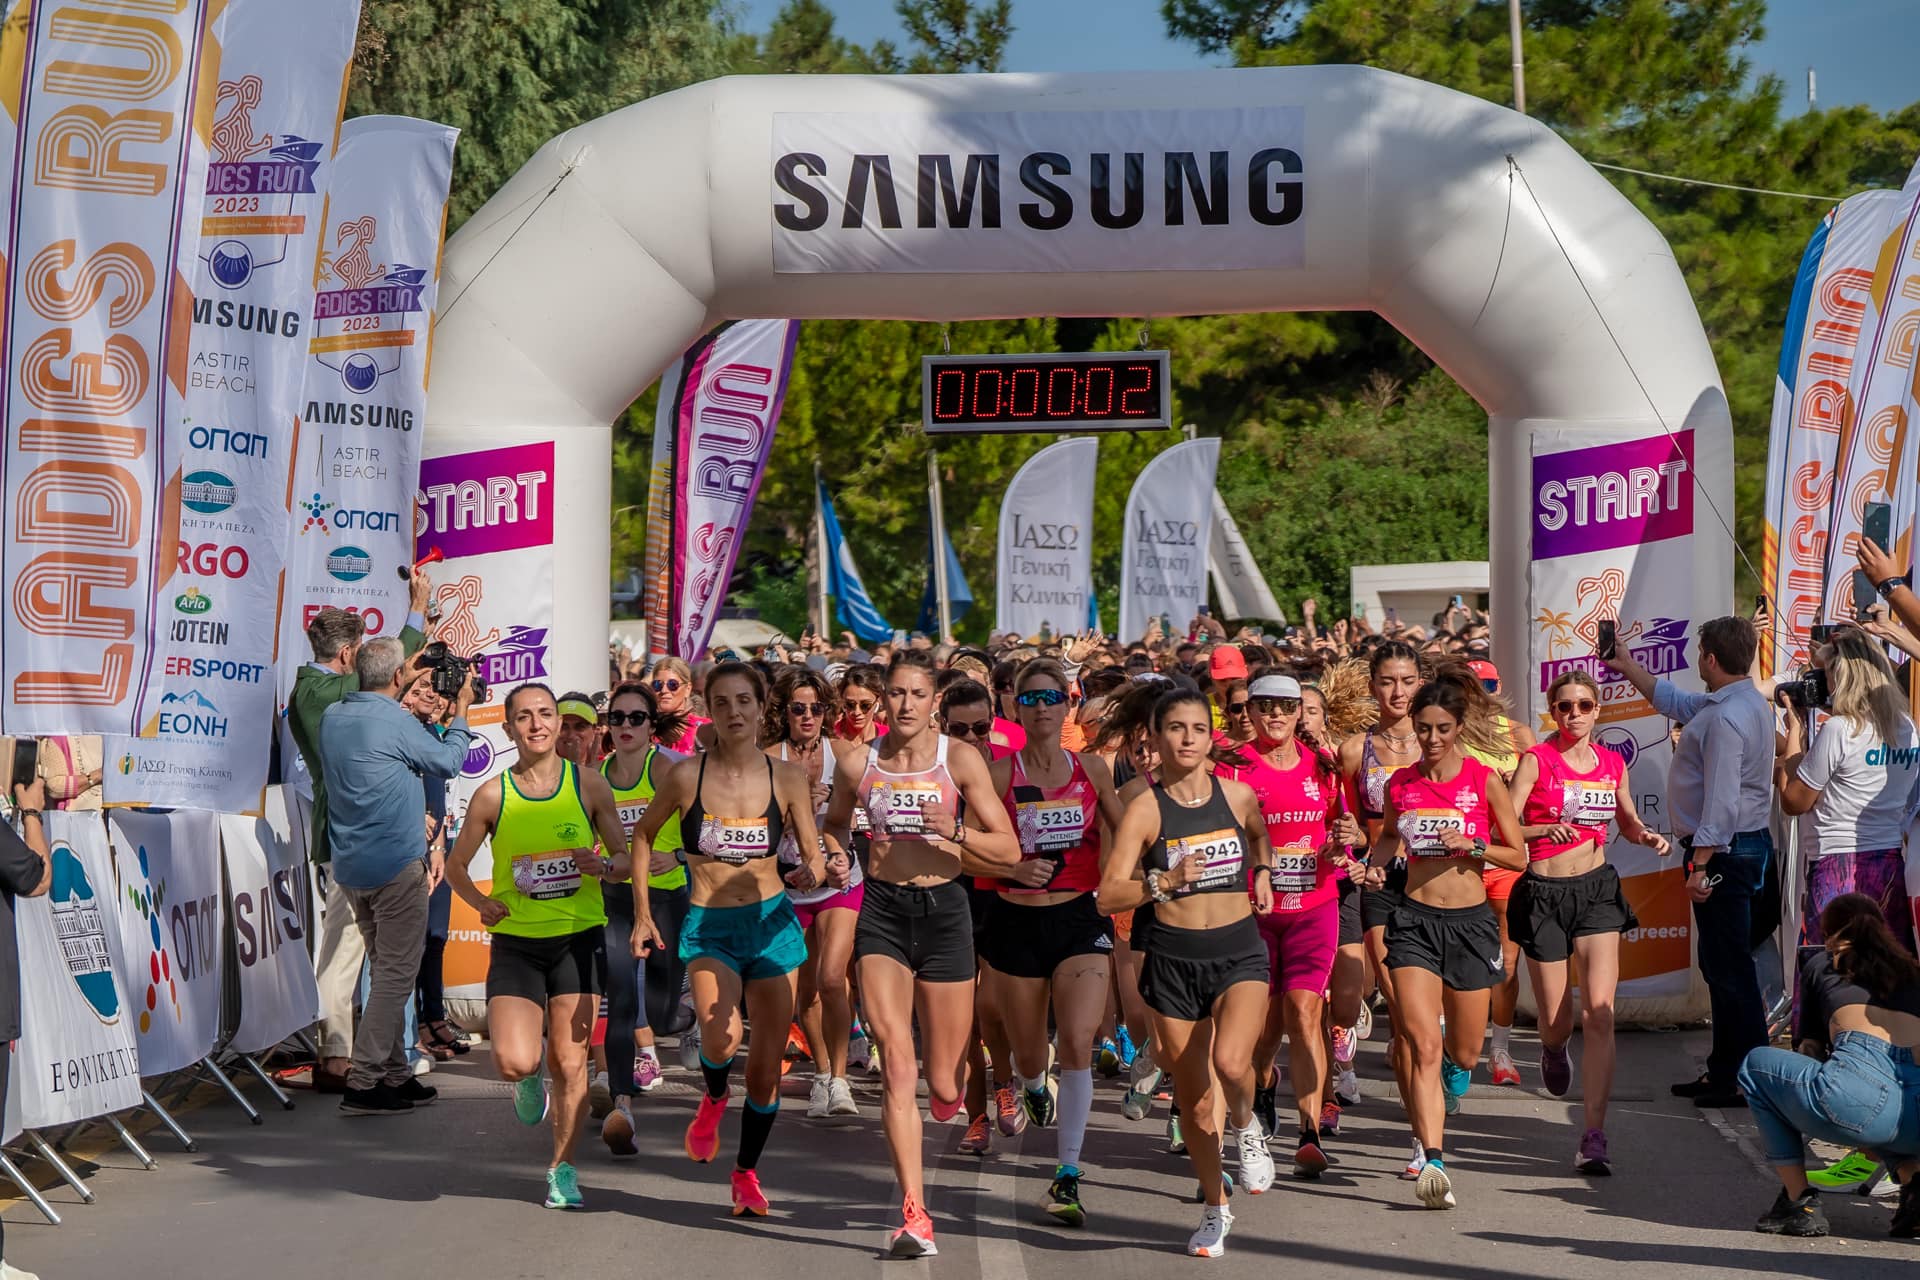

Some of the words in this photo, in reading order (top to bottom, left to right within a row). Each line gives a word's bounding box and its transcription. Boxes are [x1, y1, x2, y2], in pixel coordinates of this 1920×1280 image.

[34, 0, 188, 197] RU
[257, 165, 305, 192] RUN
[773, 148, 1304, 231] SAMSUNG
[213, 197, 260, 213] 2023
[314, 294, 372, 317] ADIES
[377, 288, 414, 312] RUN
[342, 316, 381, 332] 2023
[194, 352, 249, 372] ASTIR
[191, 372, 256, 395] BEACH
[935, 366, 1153, 418] 00:00:02
[694, 363, 772, 506] RUN
[334, 447, 380, 462] ASTIR
[332, 464, 387, 480] BEACH
[1538, 460, 1688, 531] START
[178, 596, 206, 609] Arla
[490, 652, 536, 683] RUN
[1041, 810, 1082, 826] 5236
[723, 830, 766, 842] 5865
[1195, 841, 1240, 860] 942
[536, 859, 577, 876] 5639
[1279, 857, 1316, 869] 5293
[1622, 925, 1688, 943] greece
